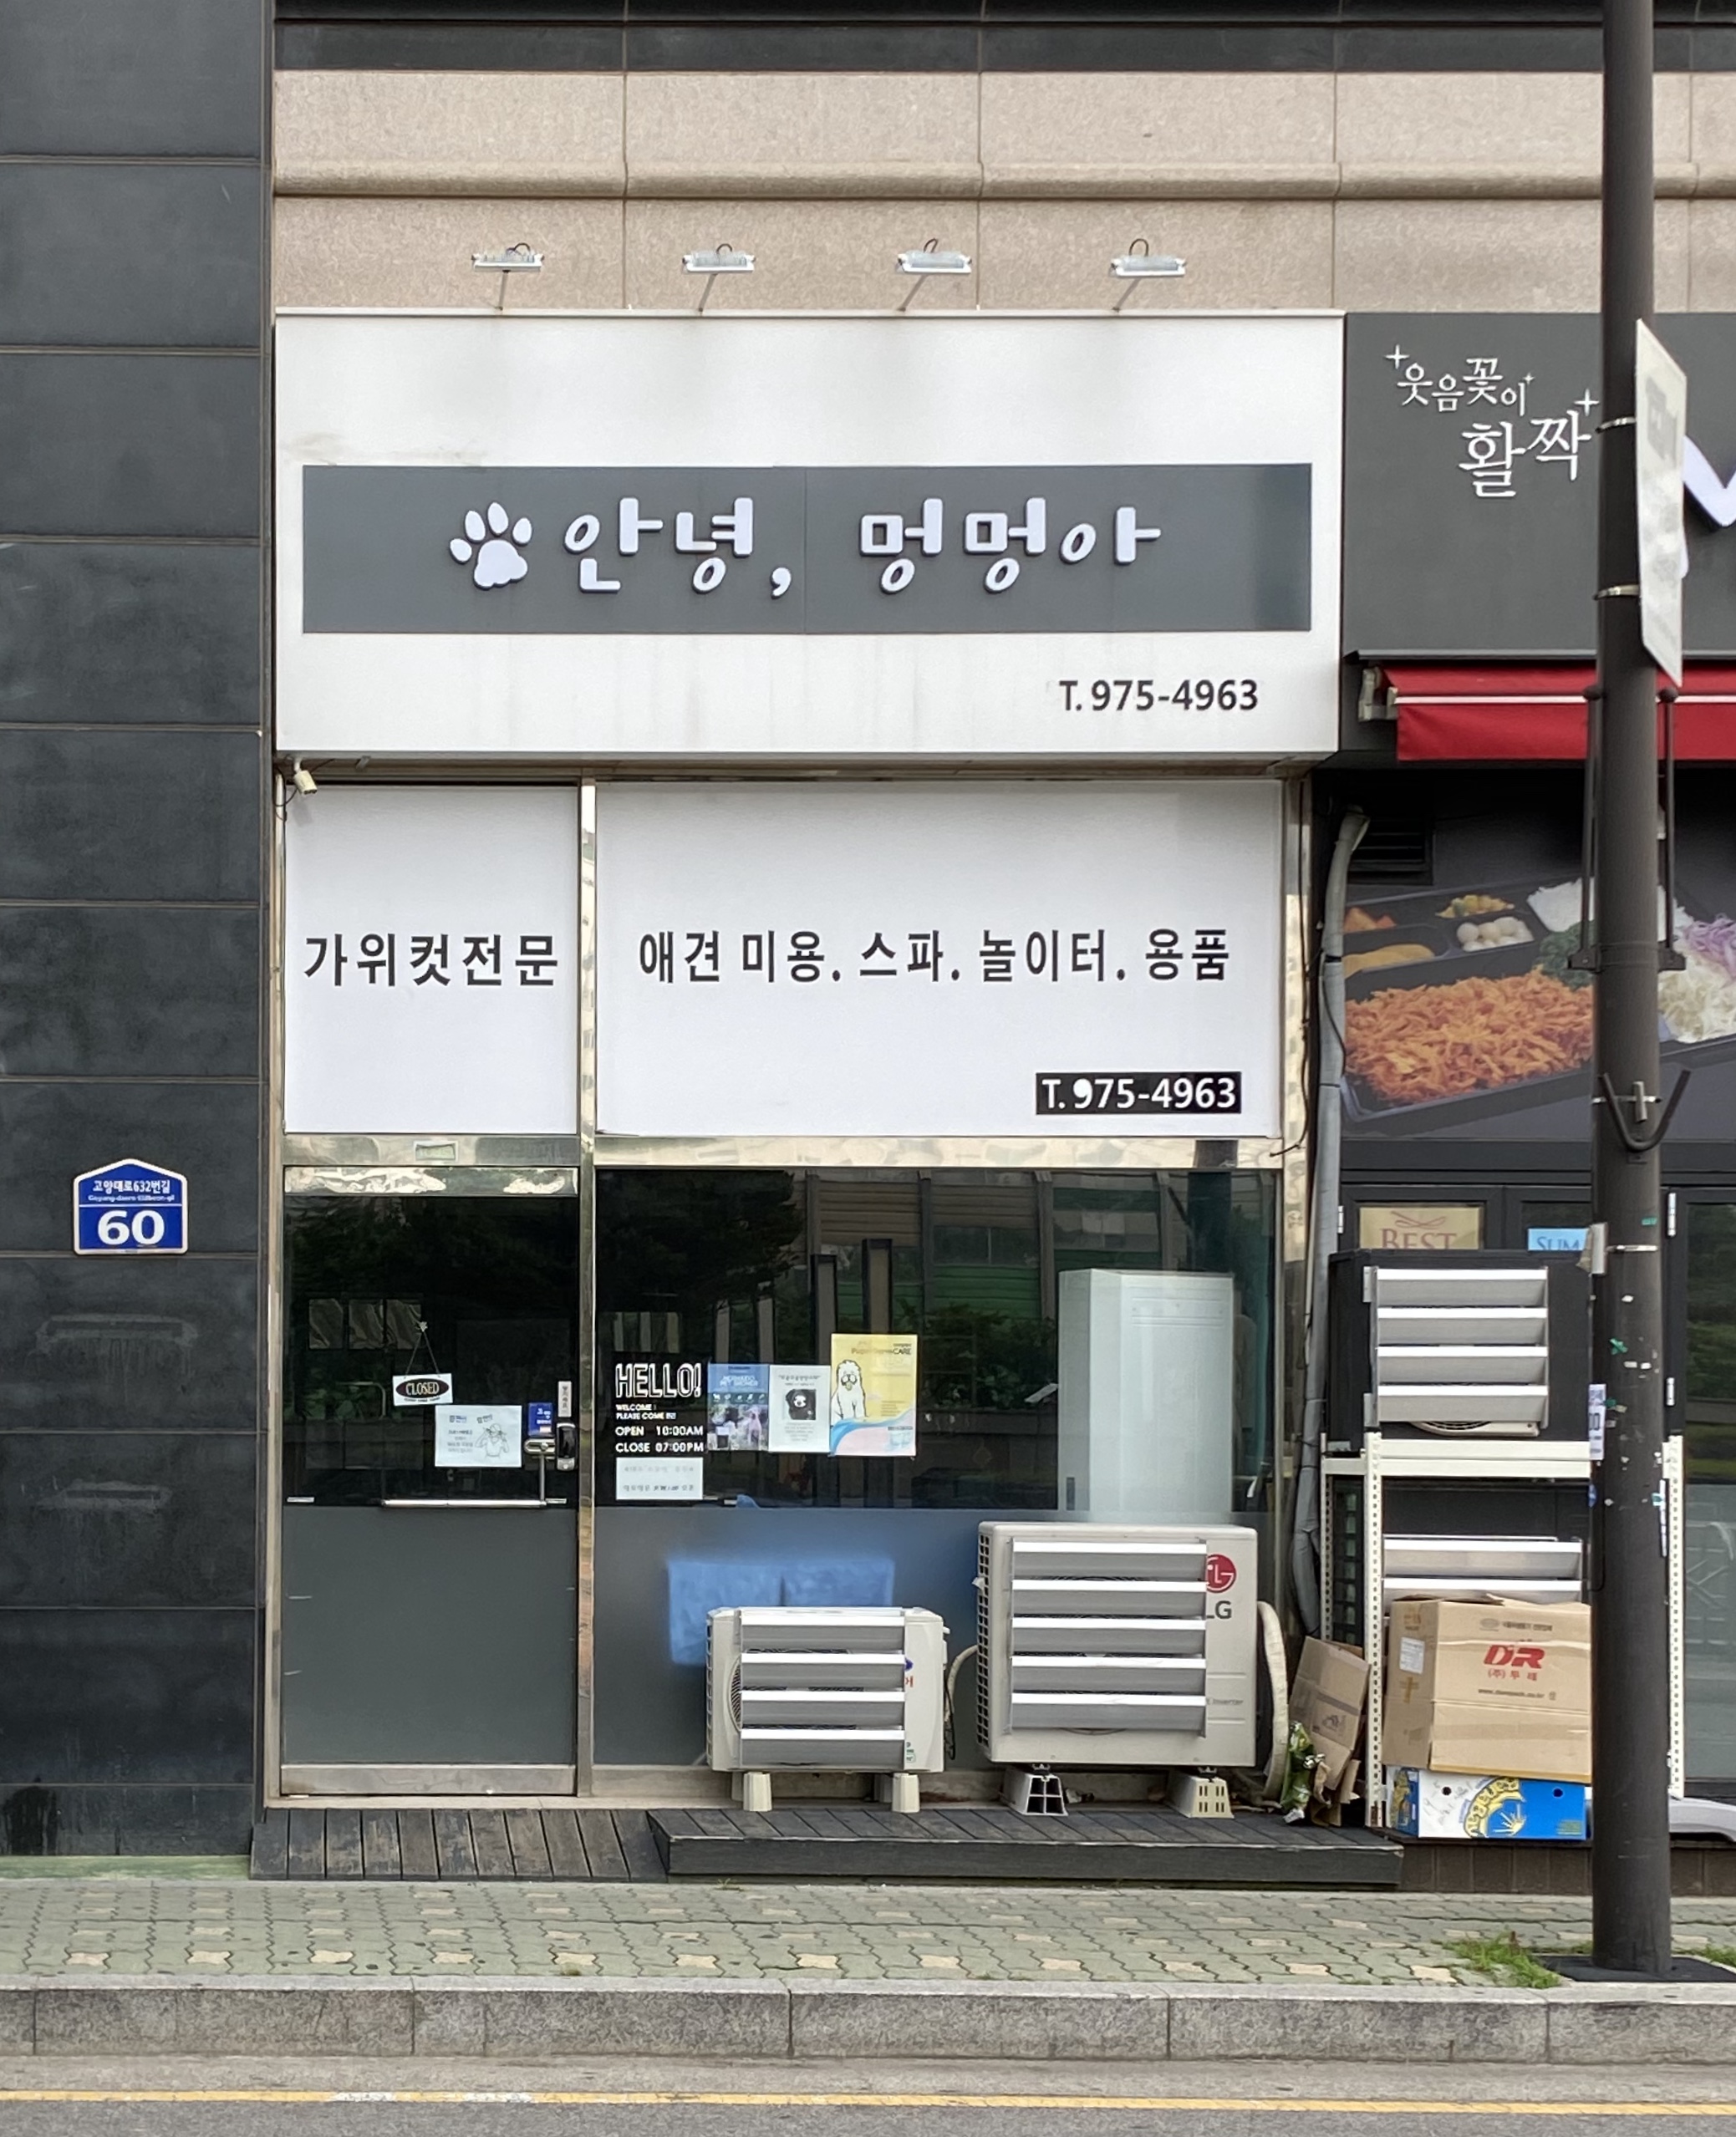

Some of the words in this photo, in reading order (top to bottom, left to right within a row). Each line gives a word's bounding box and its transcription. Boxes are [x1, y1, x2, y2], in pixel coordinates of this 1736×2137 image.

[1397, 357, 1526, 416] 웃음꽃이
[1456, 410, 1592, 498] 활짝
[564, 497, 792, 597] 안녕,
[861, 497, 1162, 592] 멍멍아
[304, 934, 557, 987] 가위컷전문
[640, 929, 720, 983] 애견
[1146, 929, 1229, 983] 용품
[93, 1180, 171, 1194] 고양대로632번길
[98, 1209, 165, 1245] 60
[405, 1381, 440, 1396] CLOSED
[615, 1362, 701, 1398] HELLO!
[615, 1426, 644, 1437] OPEN
[656, 1425, 704, 1437] 10:00AM
[615, 1442, 650, 1453] CLOSE
[655, 1442, 705, 1453] 07:00PM
